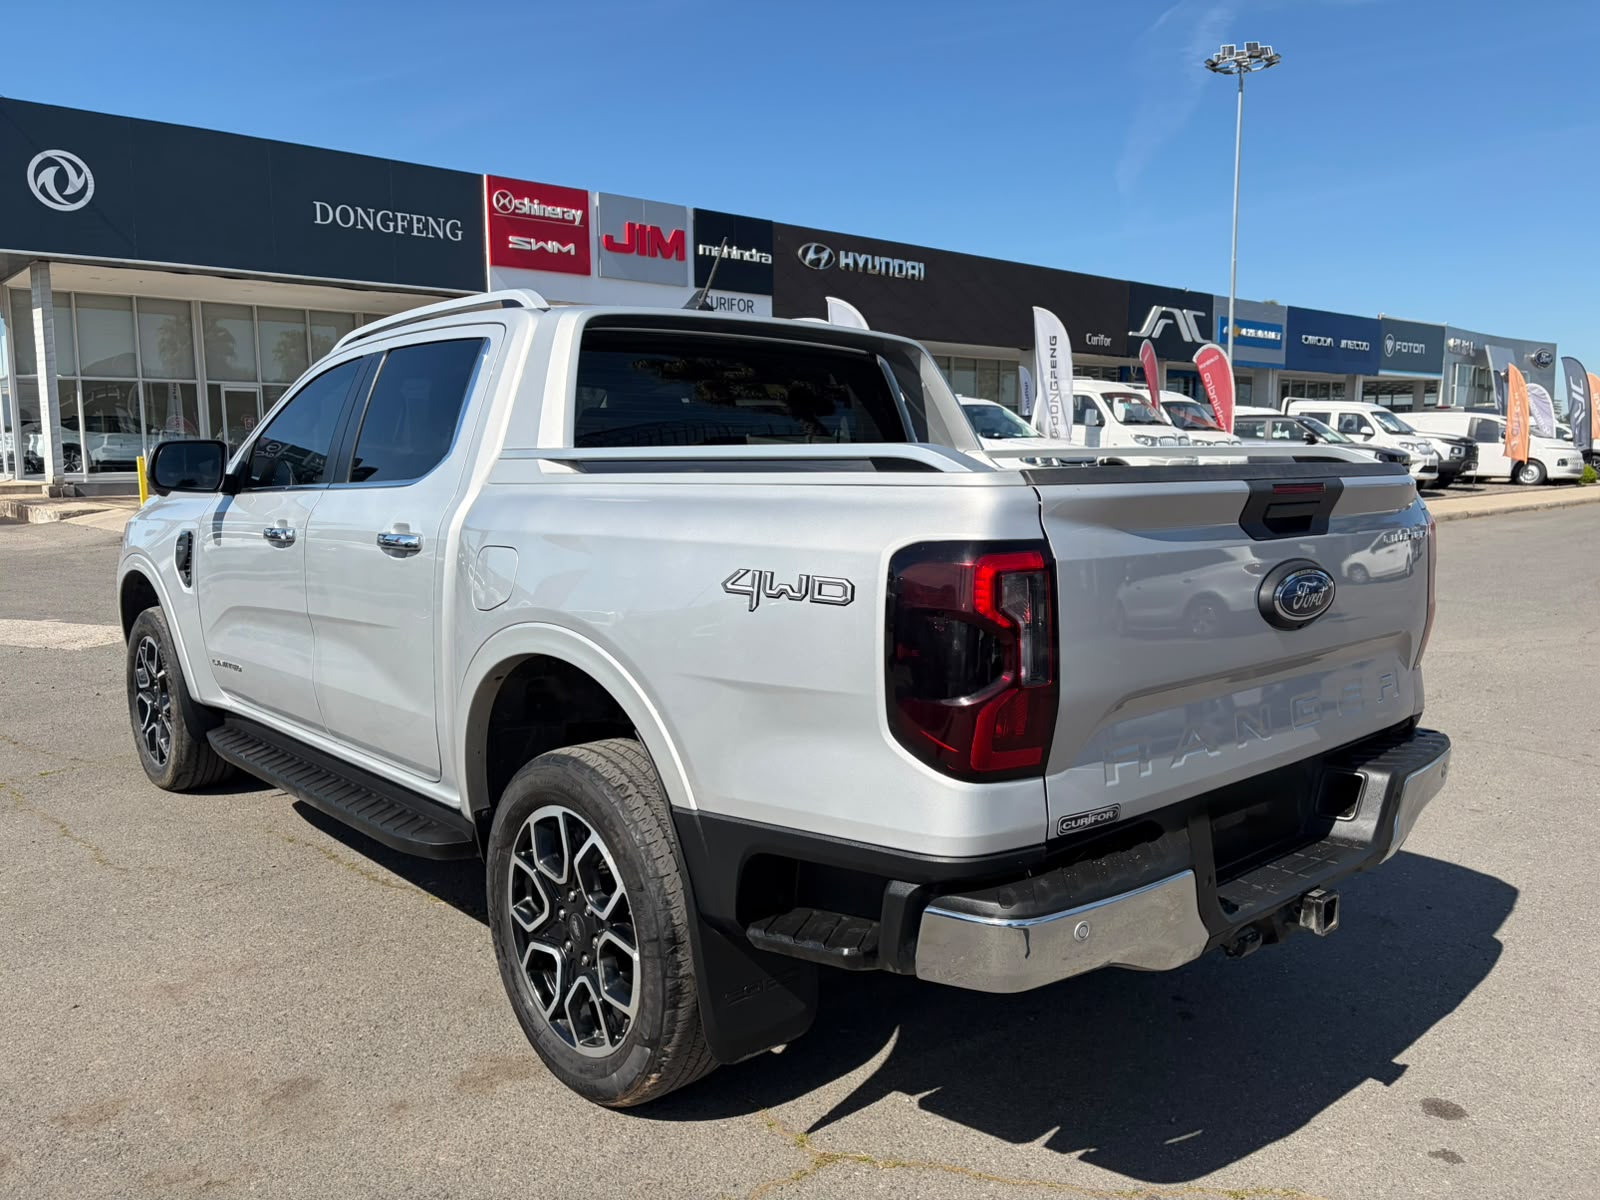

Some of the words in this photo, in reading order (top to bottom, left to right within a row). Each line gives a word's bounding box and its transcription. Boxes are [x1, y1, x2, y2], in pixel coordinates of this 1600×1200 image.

[313, 200, 463, 242] DONGFENG
[514, 197, 583, 226] shineray
[508, 235, 576, 256] SWM
[602, 221, 687, 263] JIM
[698, 243, 773, 265] mahindra
[839, 250, 925, 281] HYUNDAI
[706, 294, 755, 314] URIFOR
[1127, 305, 1213, 344] JAC
[1395, 340, 1426, 355] FOTON
[721, 568, 856, 612] 4WD
[1292, 581, 1329, 610] Ford
[1061, 810, 1114, 830] CURIFOR
